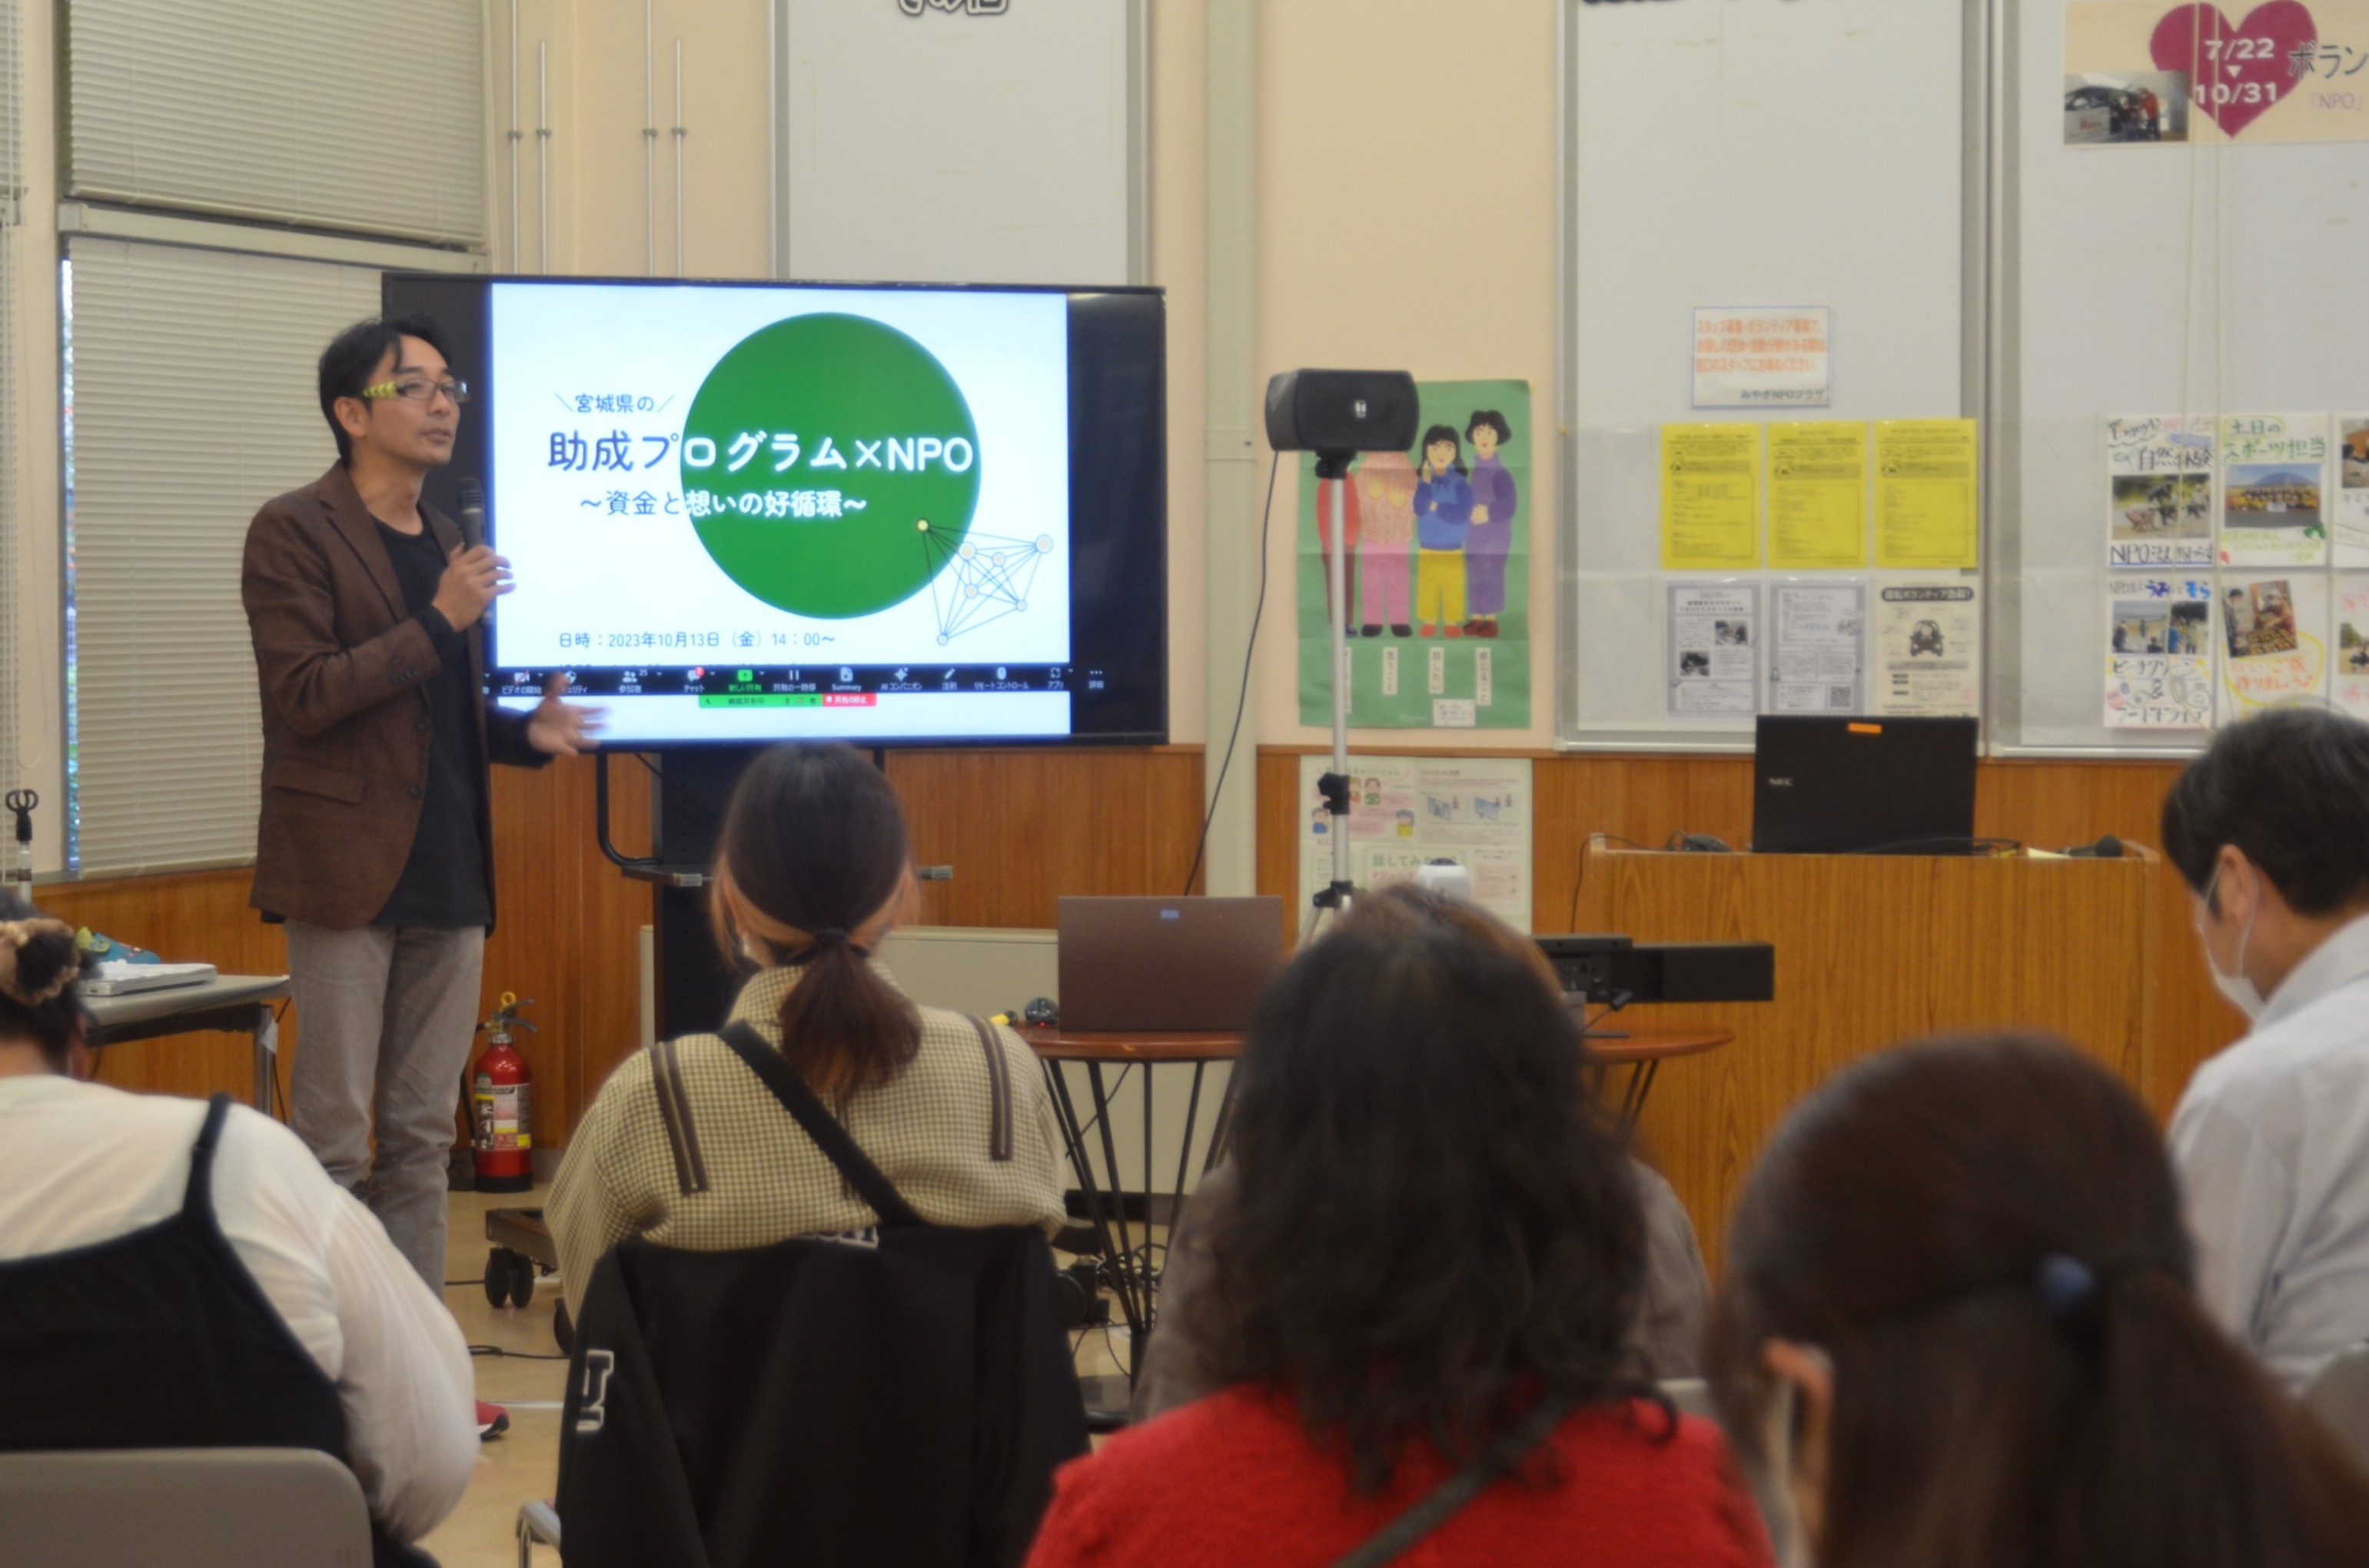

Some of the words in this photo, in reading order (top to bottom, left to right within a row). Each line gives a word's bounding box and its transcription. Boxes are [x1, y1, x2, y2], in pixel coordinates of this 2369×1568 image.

[2205, 38, 2274, 60] 7/22
[2194, 82, 2278, 105] 10/31
[2231, 419, 2281, 435] 土日の
[547, 430, 973, 473] 助成プログラム×NPO
[2224, 437, 2326, 460] スポーツ担当
[832, 683, 862, 693] Summary
[1769, 778, 1793, 786] NEC
